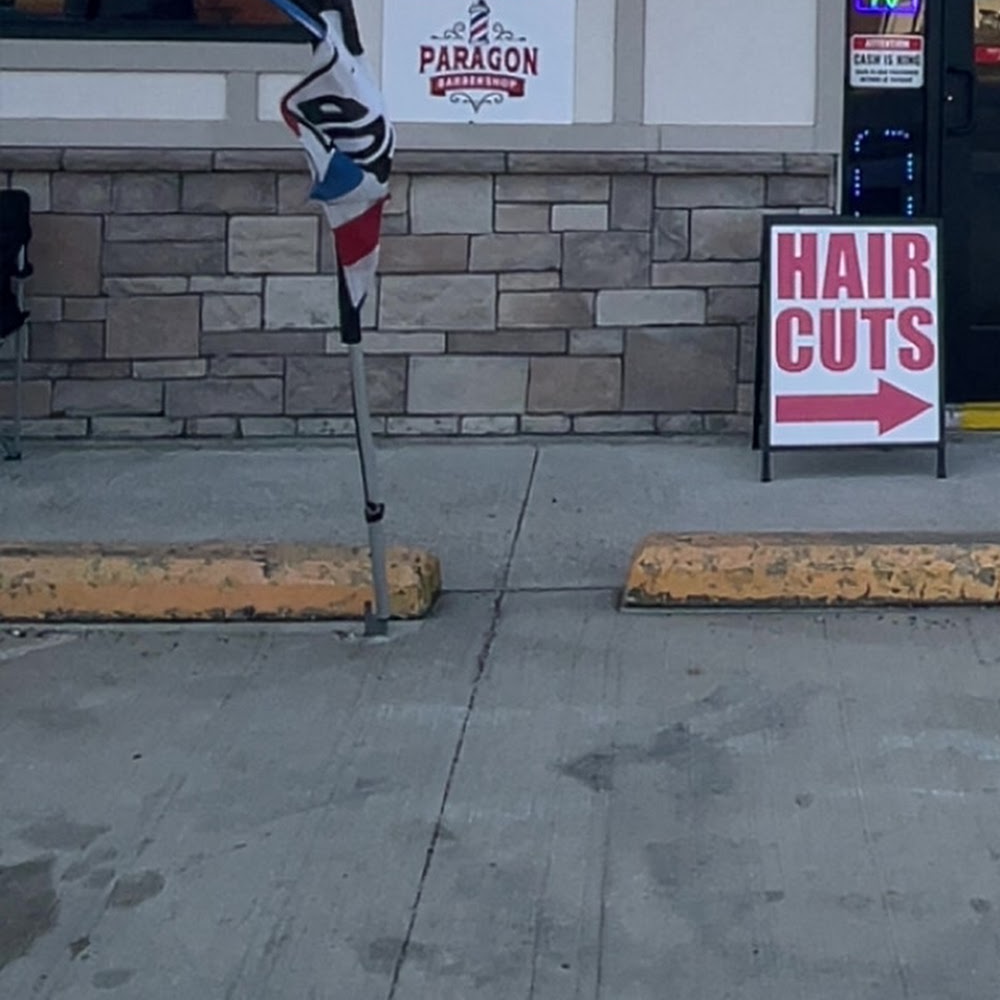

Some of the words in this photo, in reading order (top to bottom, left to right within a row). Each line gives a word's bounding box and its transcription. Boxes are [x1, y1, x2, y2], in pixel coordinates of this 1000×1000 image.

[418, 45, 539, 76] PARAGON
[854, 53, 881, 66] CASH
[884, 53, 894, 66] IS
[776, 232, 931, 300] HAIR
[774, 306, 936, 373] CUTS
